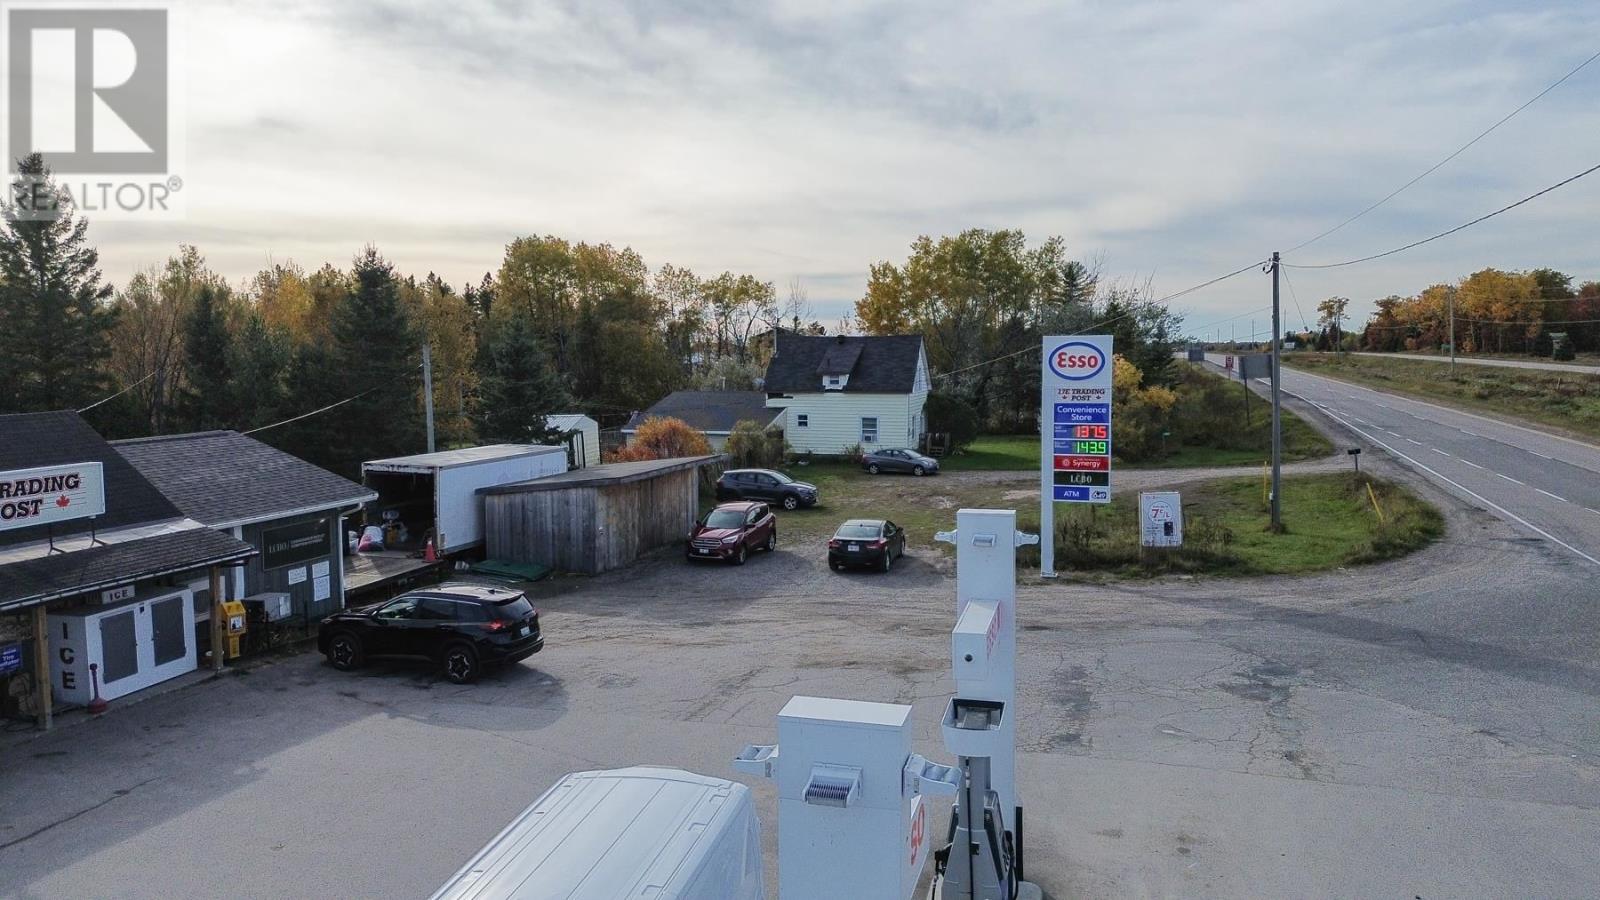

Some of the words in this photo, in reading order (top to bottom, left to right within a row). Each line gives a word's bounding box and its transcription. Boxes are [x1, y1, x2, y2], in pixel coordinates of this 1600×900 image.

[1057, 351, 1099, 369] Esso
[1057, 405, 1107, 413] Convenience
[1071, 413, 1092, 421] Store
[1073, 459, 1101, 468] Synergy
[1070, 474, 1092, 483] LCBO
[0, 499, 43, 519] OST
[109, 589, 129, 601] ICE
[60, 622, 76, 690] ICE
